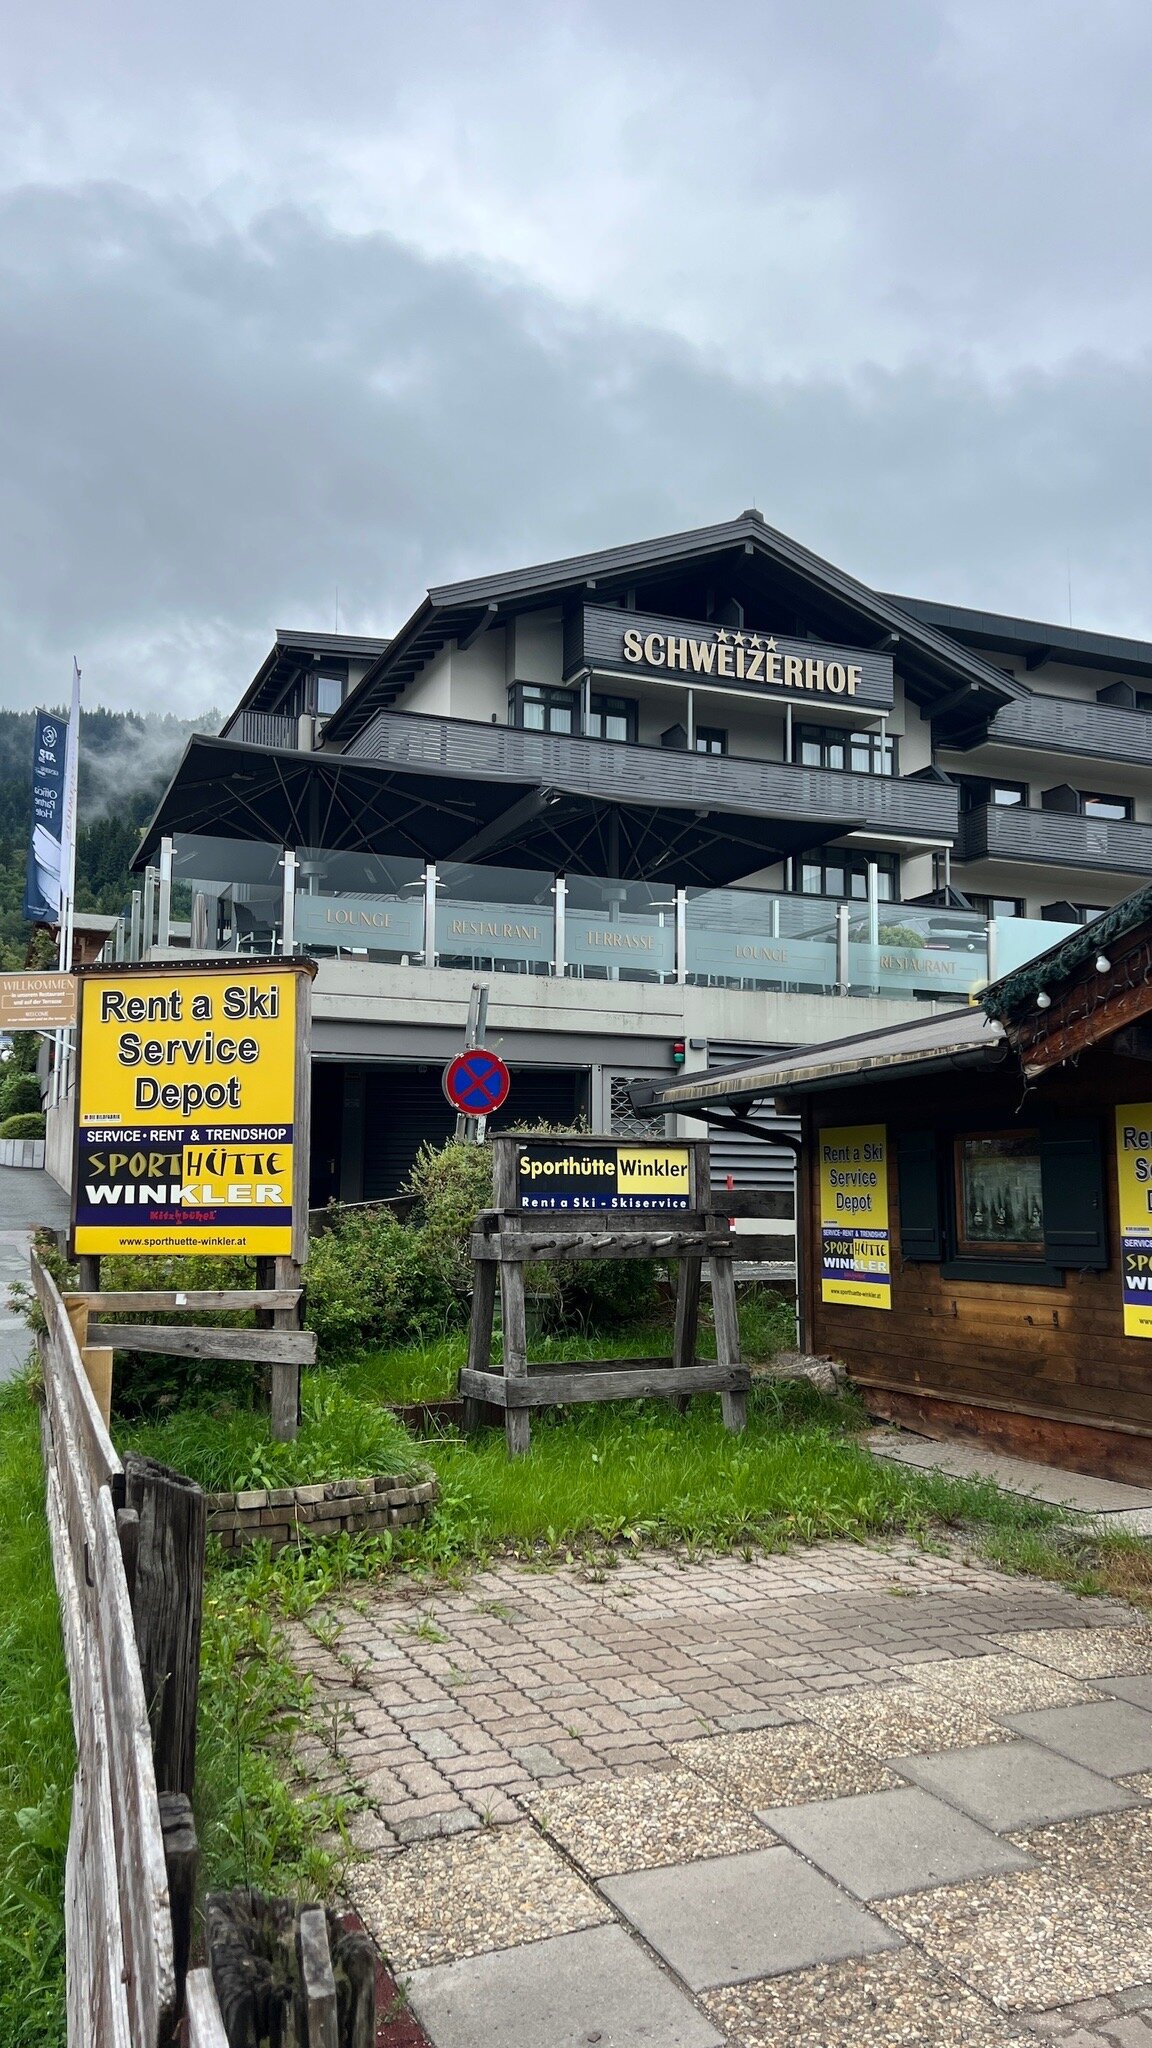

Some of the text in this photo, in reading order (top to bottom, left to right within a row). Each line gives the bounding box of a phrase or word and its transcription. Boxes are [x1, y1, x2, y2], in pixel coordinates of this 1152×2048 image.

[623, 629, 863, 695] SCHWEIZERHOF
[327, 909, 393, 928] LOUNGE
[453, 920, 541, 940] RESTAURANT
[587, 931, 655, 950] TERRASSE
[735, 945, 788, 962] LOUNGE
[880, 956, 957, 974] RESTAURANT
[3, 979, 75, 991] WILLKOMMEN
[101, 985, 279, 1021] Rent a Ski
[118, 1030, 258, 1065] Service
[135, 1075, 241, 1116] Depot
[87, 1128, 287, 1142] SERVICE RENT & TRENDSHOP
[1123, 1126, 1152, 1150] Re
[823, 1143, 883, 1162] Rent a Ski
[519, 1156, 688, 1179] Sporthütte Winkler
[830, 1168, 877, 1186] Service
[85, 1184, 284, 1204] WINKLER
[522, 1197, 555, 1208] Rent
[560, 1200, 568, 1208] a
[573, 1197, 596, 1208] Ski
[611, 1197, 687, 1208] Skiservice
[836, 1192, 872, 1214] Depot
[119, 1237, 247, 1247] www.sporthuette-winkler.at
[860, 1230, 887, 1238] TRENDSHOP
[823, 1257, 887, 1272] WINKLER
